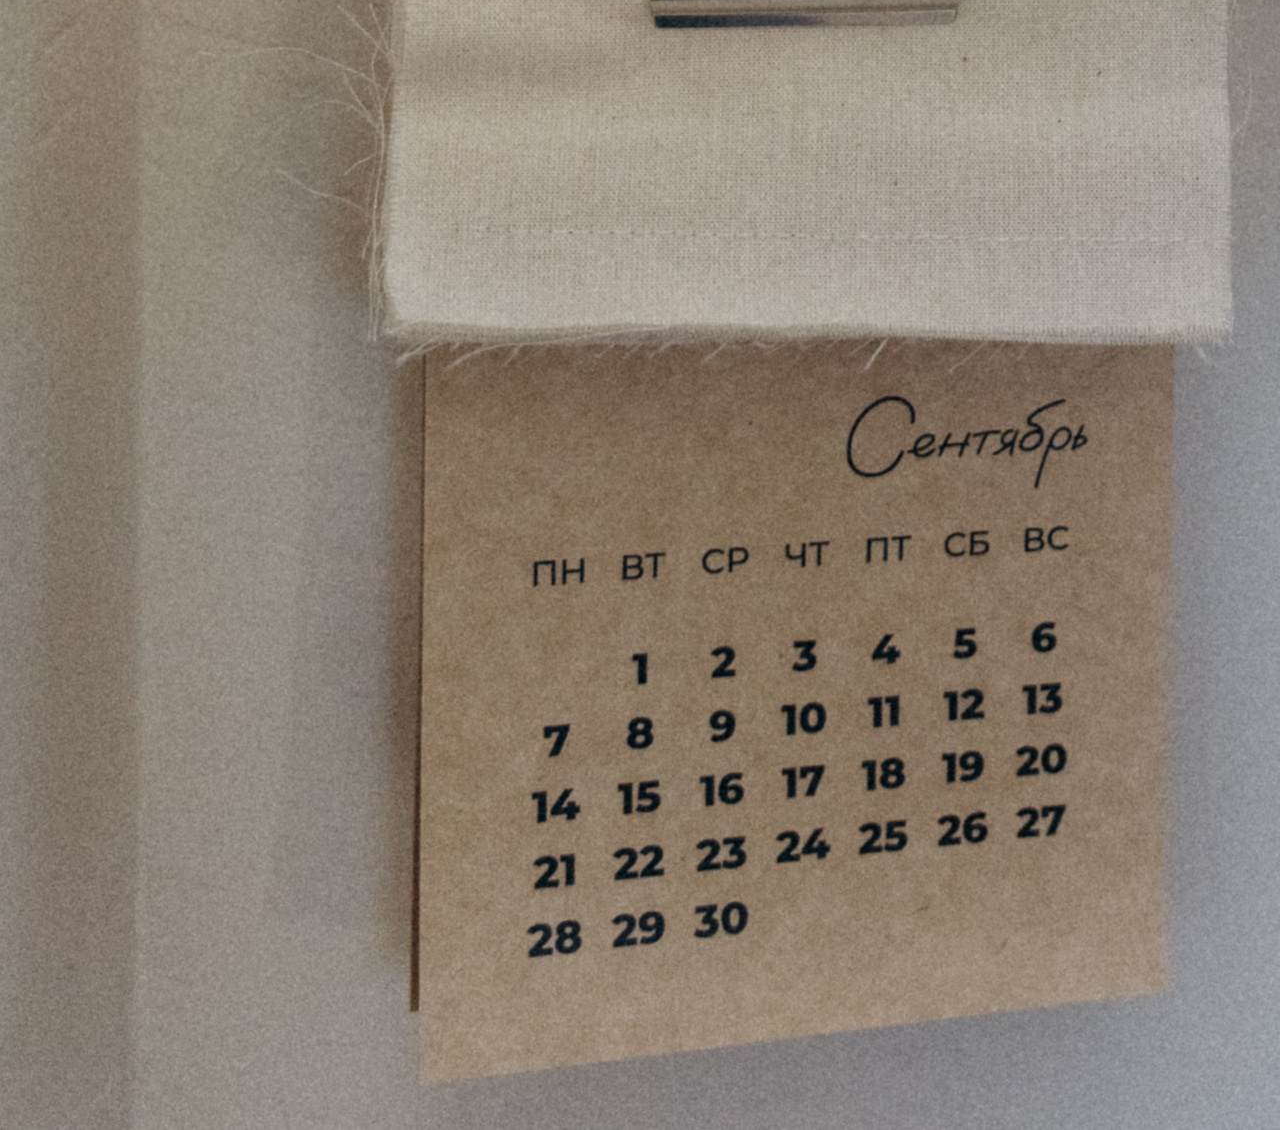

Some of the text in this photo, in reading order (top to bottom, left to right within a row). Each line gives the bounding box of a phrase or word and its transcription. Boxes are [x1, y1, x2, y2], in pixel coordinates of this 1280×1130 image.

[845, 394, 1089, 490] Сентябрь
[531, 524, 1070, 588] ПН ВТ СР ЧТ ПТ СБ ВС
[630, 620, 1058, 686] 1 2 3 4 5 6
[542, 681, 1064, 759] 7 8 9 10 11 12 13
[530, 742, 1069, 825] 14 15 16 17 18 19 20
[532, 803, 1068, 891] 21 22 23 24 25 26 27
[526, 900, 750, 959] 28 29 30
